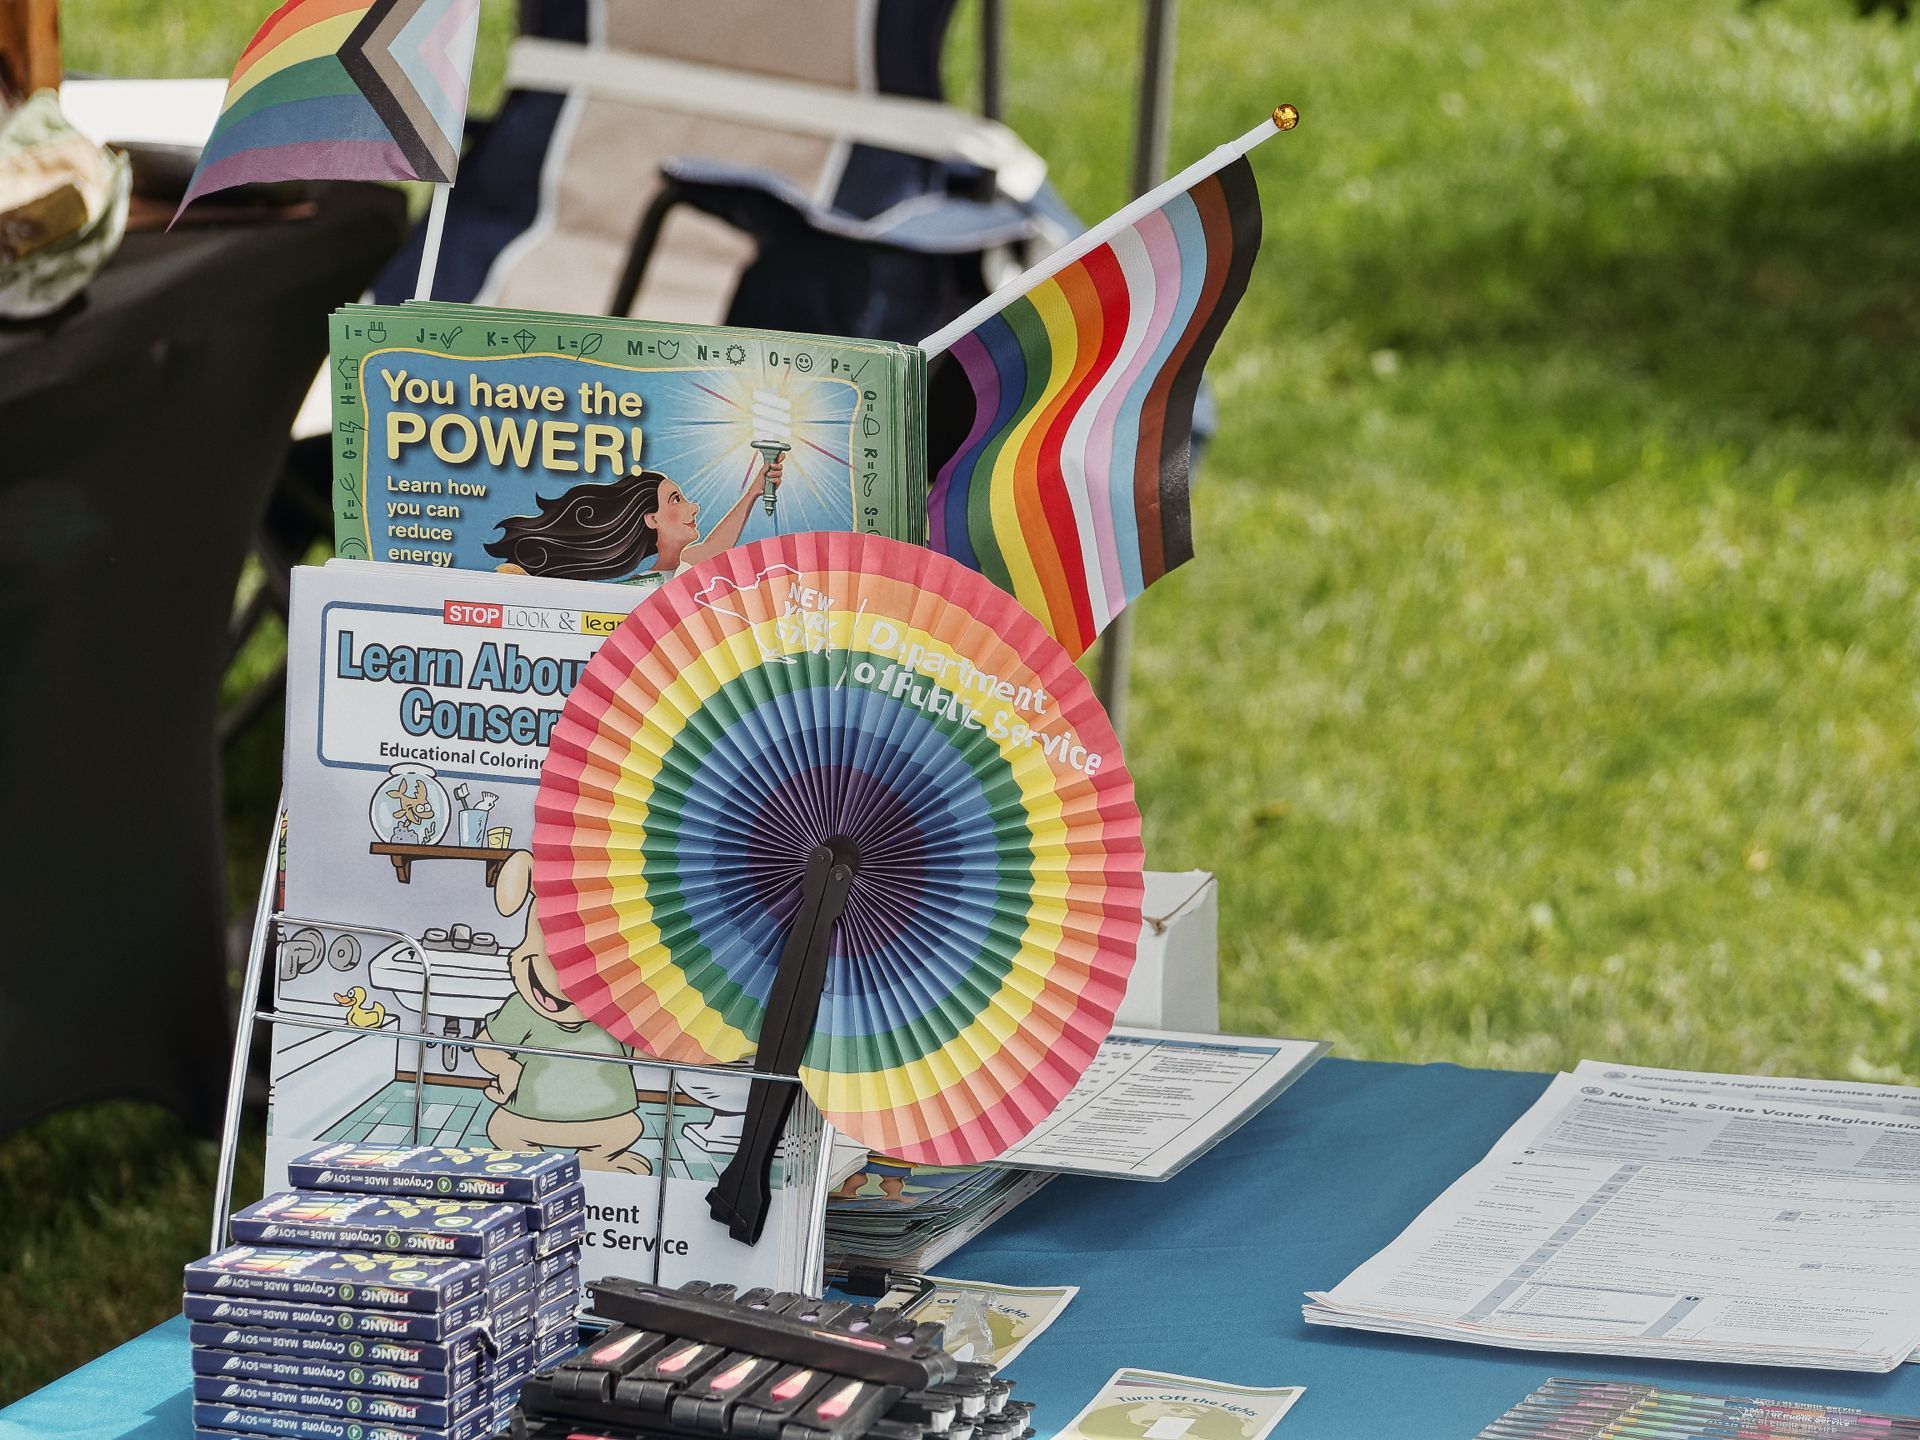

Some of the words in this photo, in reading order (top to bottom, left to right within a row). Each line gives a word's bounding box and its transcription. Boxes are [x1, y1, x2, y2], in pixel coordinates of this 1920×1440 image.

[381, 368, 455, 405] You
[469, 373, 565, 411] have
[578, 381, 643, 417] the
[386, 411, 643, 477] POWER!
[387, 476, 443, 494] Learn
[448, 479, 486, 497] how
[386, 502, 420, 521] you
[426, 504, 460, 518] can
[388, 523, 453, 541] reduce
[388, 547, 453, 567] energy
[788, 582, 834, 612] NEW
[449, 605, 500, 624] STOP
[507, 609, 551, 629] LOOK
[558, 612, 576, 631] &
[784, 600, 838, 640] YORK
[337, 630, 463, 688] Learn
[468, 640, 598, 697] Abou
[868, 619, 1048, 714] Dpartment
[400, 687, 564, 747] Conser
[987, 710, 1102, 775] Service
[379, 741, 475, 765] Educational
[1583, 1098, 1635, 1108] Register
[1609, 1092, 1652, 1102] New
[1660, 1098, 1697, 1108] York
[1704, 1103, 1755, 1114] State
[1761, 1109, 1813, 1119] Voter
[333, 1174, 351, 1185] SOY
[364, 1176, 389, 1186] MADE
[393, 1176, 434, 1190] Crayons
[278, 1228, 296, 1238] SOY
[311, 1229, 336, 1240] MADE
[339, 1230, 382, 1244] Crayons
[602, 1228, 689, 1256] Servce
[232, 1278, 250, 1290] SOY
[264, 1281, 289, 1292] MADE
[293, 1282, 336, 1298] Crayons
[230, 1307, 249, 1318] SOY
[263, 1309, 289, 1321] MADE
[292, 1310, 335, 1326] Crayons
[240, 1334, 258, 1346] SOY
[273, 1337, 298, 1348] MADE
[302, 1338, 345, 1354] Crayons
[240, 1360, 259, 1372] SOY
[273, 1363, 298, 1375] MADE
[302, 1364, 345, 1381] Crayons
[240, 1388, 257, 1400] SOY
[272, 1392, 297, 1403] MADE
[301, 1393, 343, 1410] Crayons
[1115, 1395, 1155, 1404] Turn
[1158, 1394, 1188, 1402] Off
[1192, 1397, 1219, 1406] the
[1221, 1402, 1259, 1417] Lights
[240, 1414, 258, 1426] SOY
[272, 1417, 298, 1430] MADE
[301, 1419, 344, 1437] Crayons
[1814, 1417, 1850, 1427] Service
